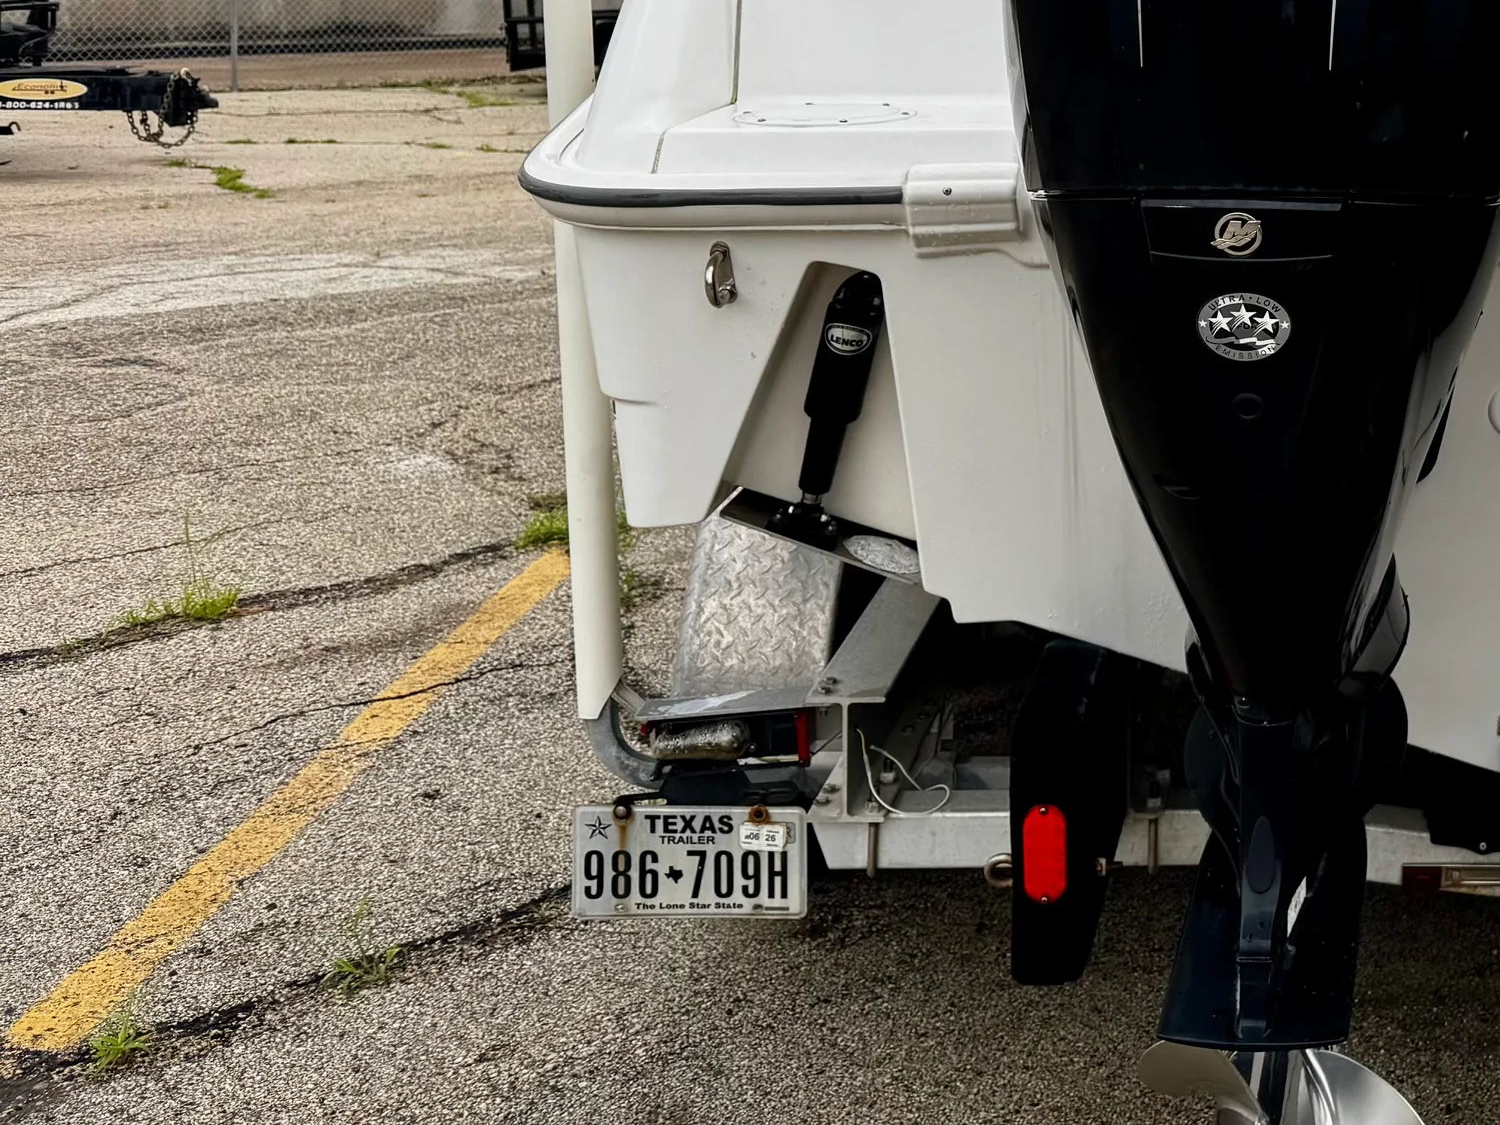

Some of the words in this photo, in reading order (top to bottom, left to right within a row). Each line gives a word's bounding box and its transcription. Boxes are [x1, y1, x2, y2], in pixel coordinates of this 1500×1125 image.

[1208, 294, 1246, 311] ULTRA
[1256, 297, 1281, 314] LOW
[830, 334, 864, 348] LENCO
[1215, 344, 1276, 360] EMISSION
[644, 814, 734, 835] TEXAS
[659, 835, 716, 845] TRAILER
[765, 834, 776, 842] 26
[584, 849, 660, 900] 986
[686, 849, 788, 900] 709H
[634, 902, 656, 910] The
[659, 902, 686, 910] Lone
[688, 902, 711, 910] Star
[714, 902, 744, 910] State
